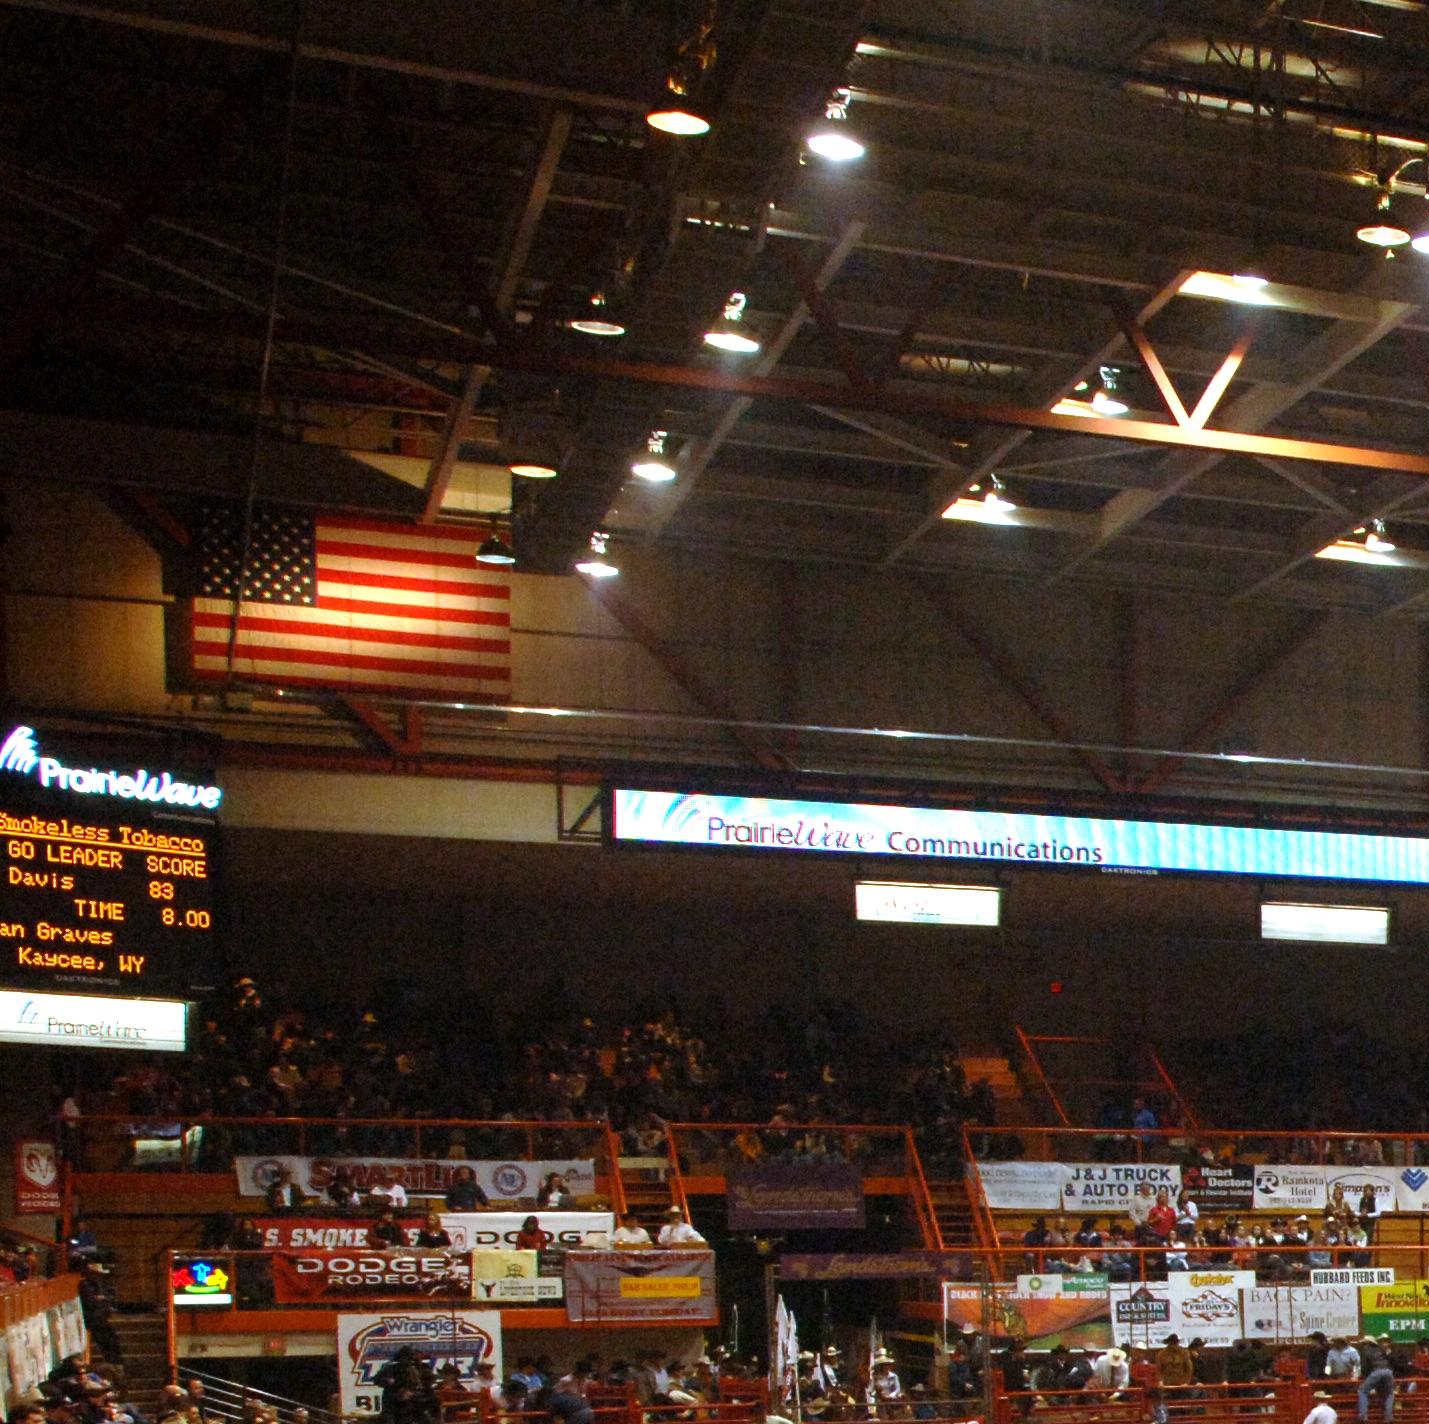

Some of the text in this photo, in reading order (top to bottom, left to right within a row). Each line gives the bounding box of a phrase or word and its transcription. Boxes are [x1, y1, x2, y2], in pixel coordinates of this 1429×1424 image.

[40, 758, 222, 809] PrairieWave
[119, 827, 203, 851] Tobacco
[707, 816, 1103, 864] PrairieWave Communications
[9, 841, 206, 878] GO LEADER SCORE
[9, 867, 173, 899] Davis 83
[74, 900, 210, 928] TIME 8.00
[37, 922, 113, 945] Graves
[18, 947, 144, 974] Kaycee, WY
[1113, 1168, 1170, 1181] TRUCK
[1201, 1168, 1232, 1177] Heart
[1065, 1183, 1129, 1196] & AUTO
[1208, 1177, 1252, 1187] Doctors
[1291, 1187, 1316, 1196] Hotel
[298, 1258, 447, 1273] DODGE
[328, 1274, 419, 1285] RODEO
[1313, 1271, 1375, 1284] HUBBARD FEEDS
[1250, 1290, 1297, 1302] BACK
[1120, 1302, 1166, 1312] COUNTRY
[385, 1319, 460, 1338] Wrangler
[1300, 1312, 1324, 1332] Spine
[1389, 1319, 1425, 1330] EPM
